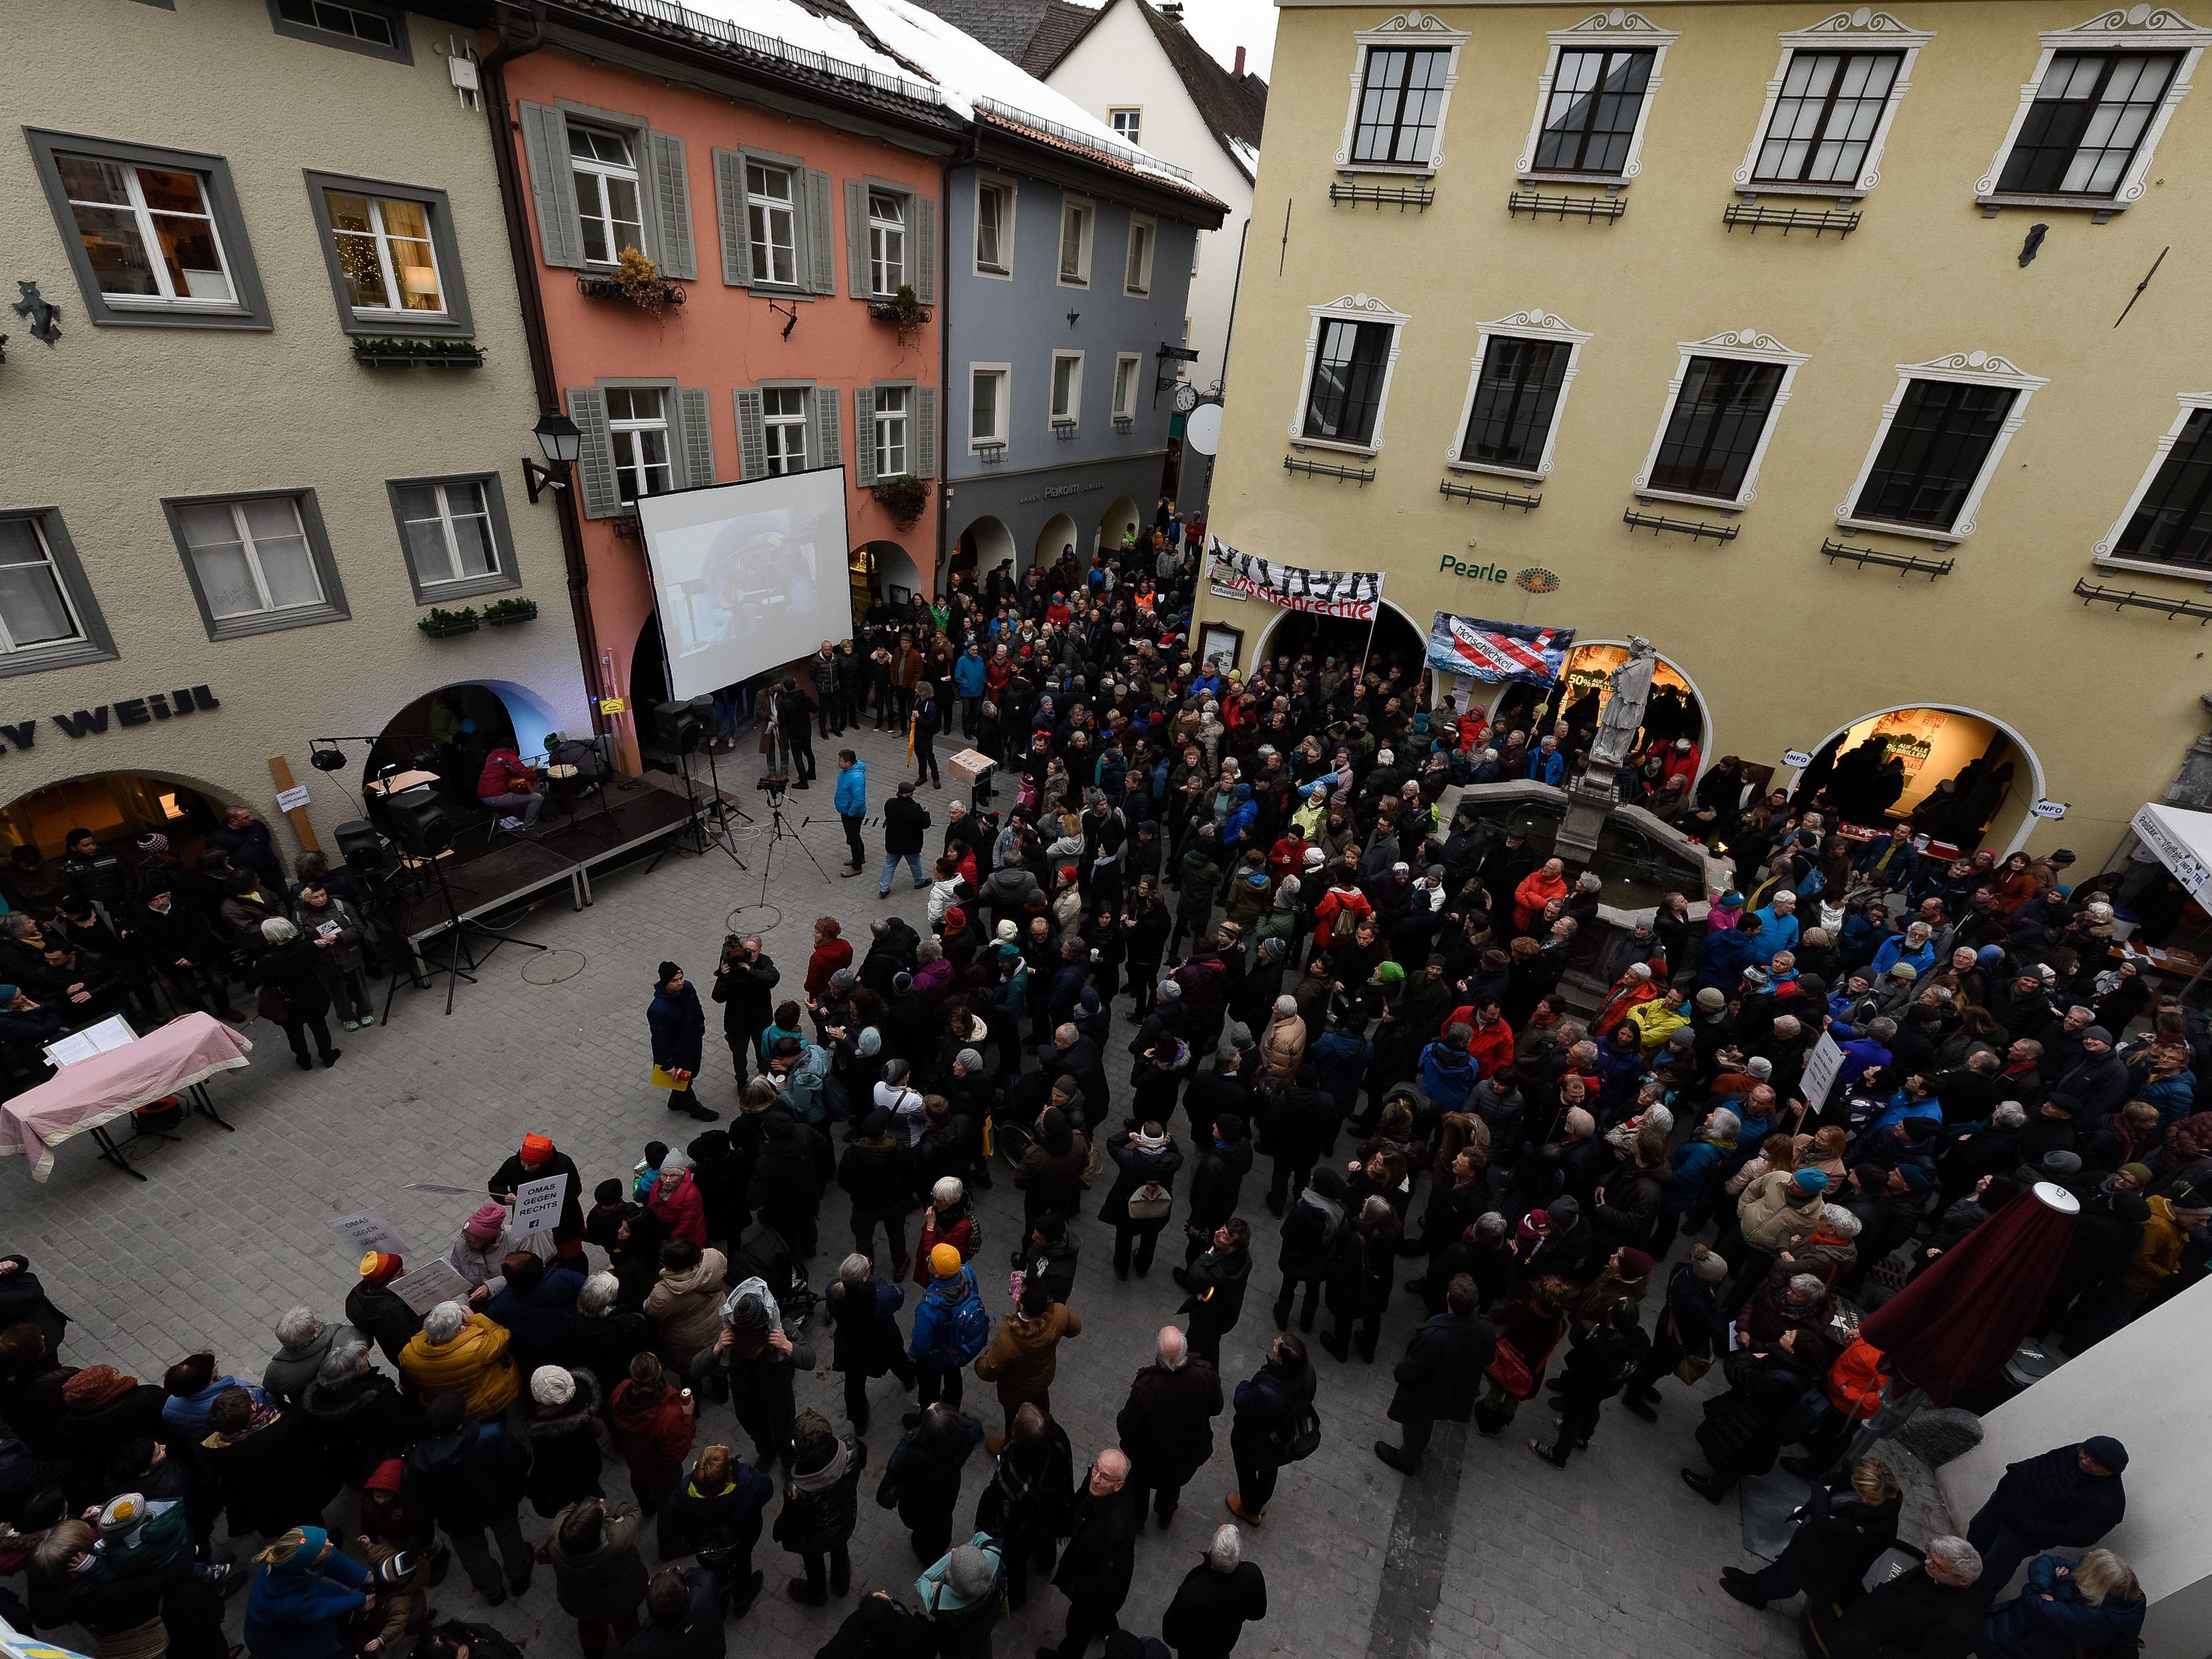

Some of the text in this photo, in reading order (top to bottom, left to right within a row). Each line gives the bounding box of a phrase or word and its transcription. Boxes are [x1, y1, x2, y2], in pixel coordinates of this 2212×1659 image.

[1045, 484, 1079, 499] Plakolm
[1439, 554, 1508, 583] Pearle
[1212, 586, 1245, 599] Rathausgasse
[1456, 625, 1515, 670] Menschlichkeit
[1568, 673, 1591, 688] 50%
[1591, 678, 1604, 686] AUF
[1786, 755, 1807, 763] INFO
[1896, 747, 1927, 759] BRILLEN
[281, 790, 302, 800] VORSICHT
[2038, 805, 2062, 813] INFO
[2138, 815, 2158, 837] Polster
[2161, 838, 2184, 863] Vielfalt
[2179, 861, 2203, 886] INFO TEE
[528, 1183, 556, 1196] OMAS
[523, 1192, 557, 1206] GEGEN
[519, 1200, 558, 1216] RECHTS
[345, 1217, 369, 1228] OMAS
[353, 1225, 378, 1237] GEGEN
